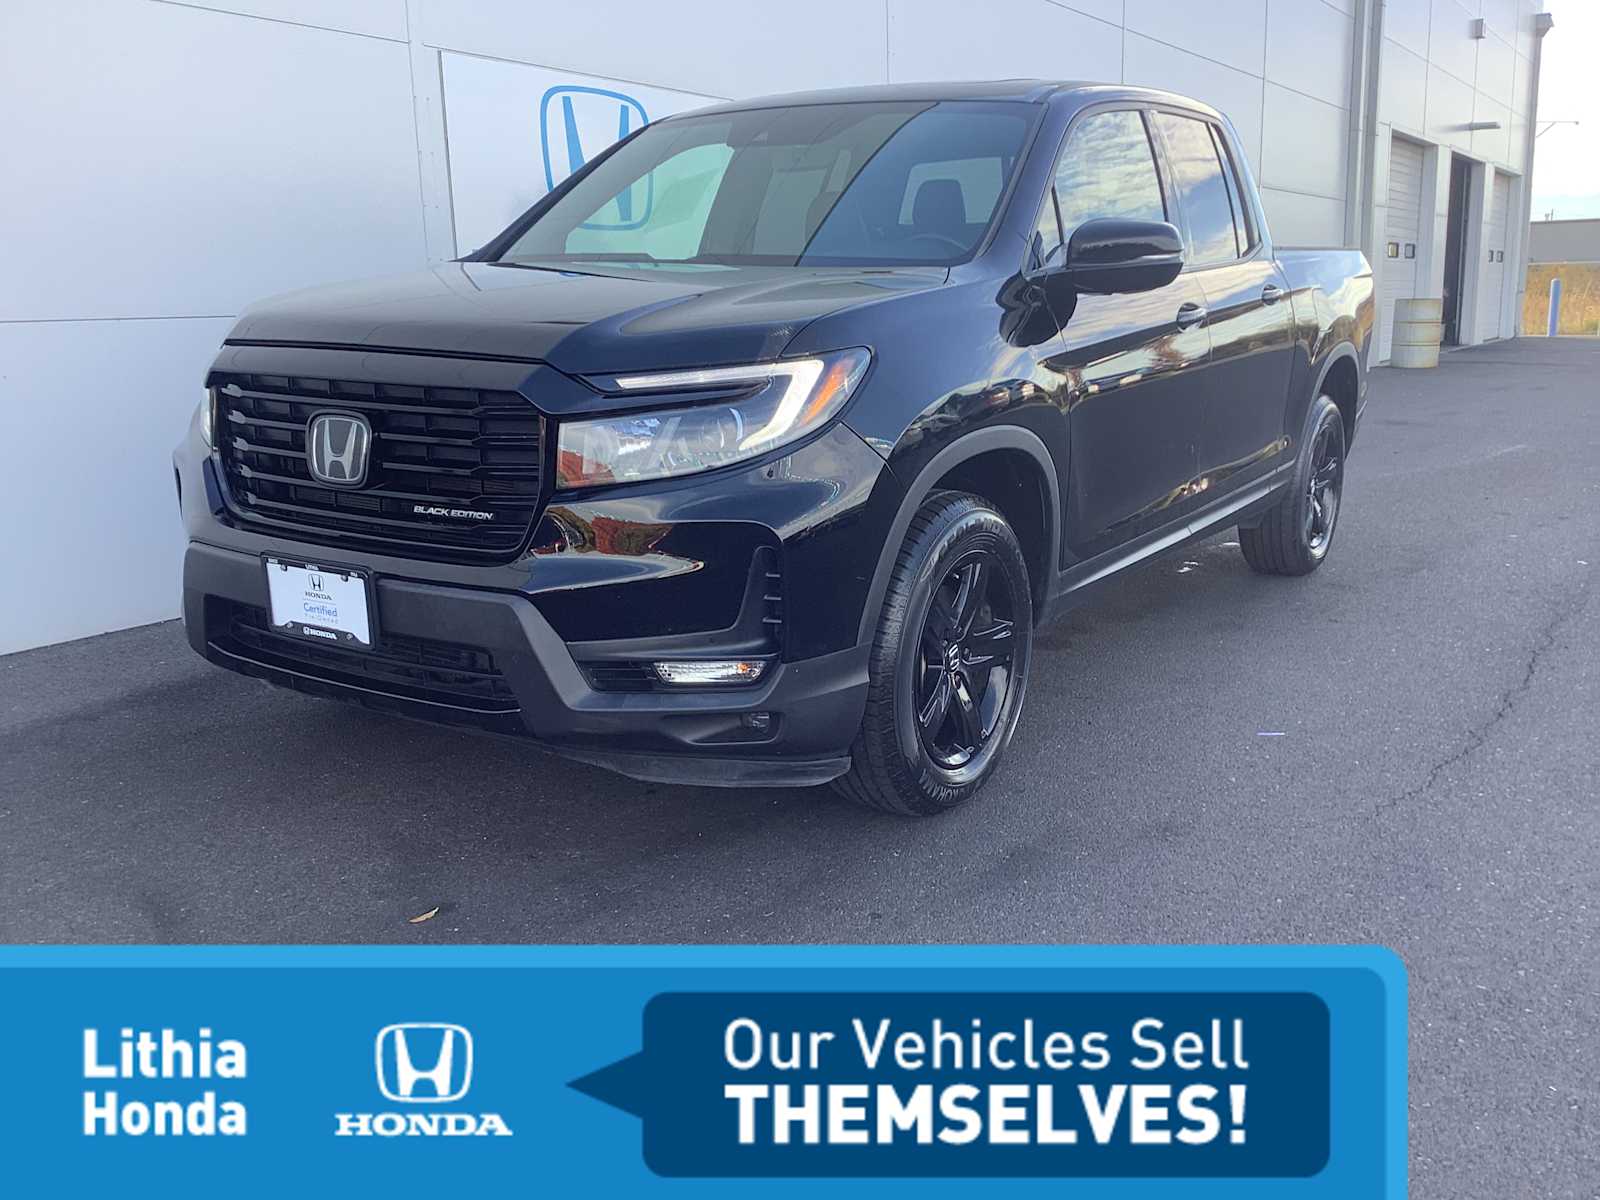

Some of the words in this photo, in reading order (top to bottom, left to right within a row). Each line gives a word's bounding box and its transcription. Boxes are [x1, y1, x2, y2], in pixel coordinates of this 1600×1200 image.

[413, 505, 450, 517] BLACK
[450, 509, 494, 520] EDITION
[304, 591, 332, 601] HONDA
[303, 602, 338, 617] Certified
